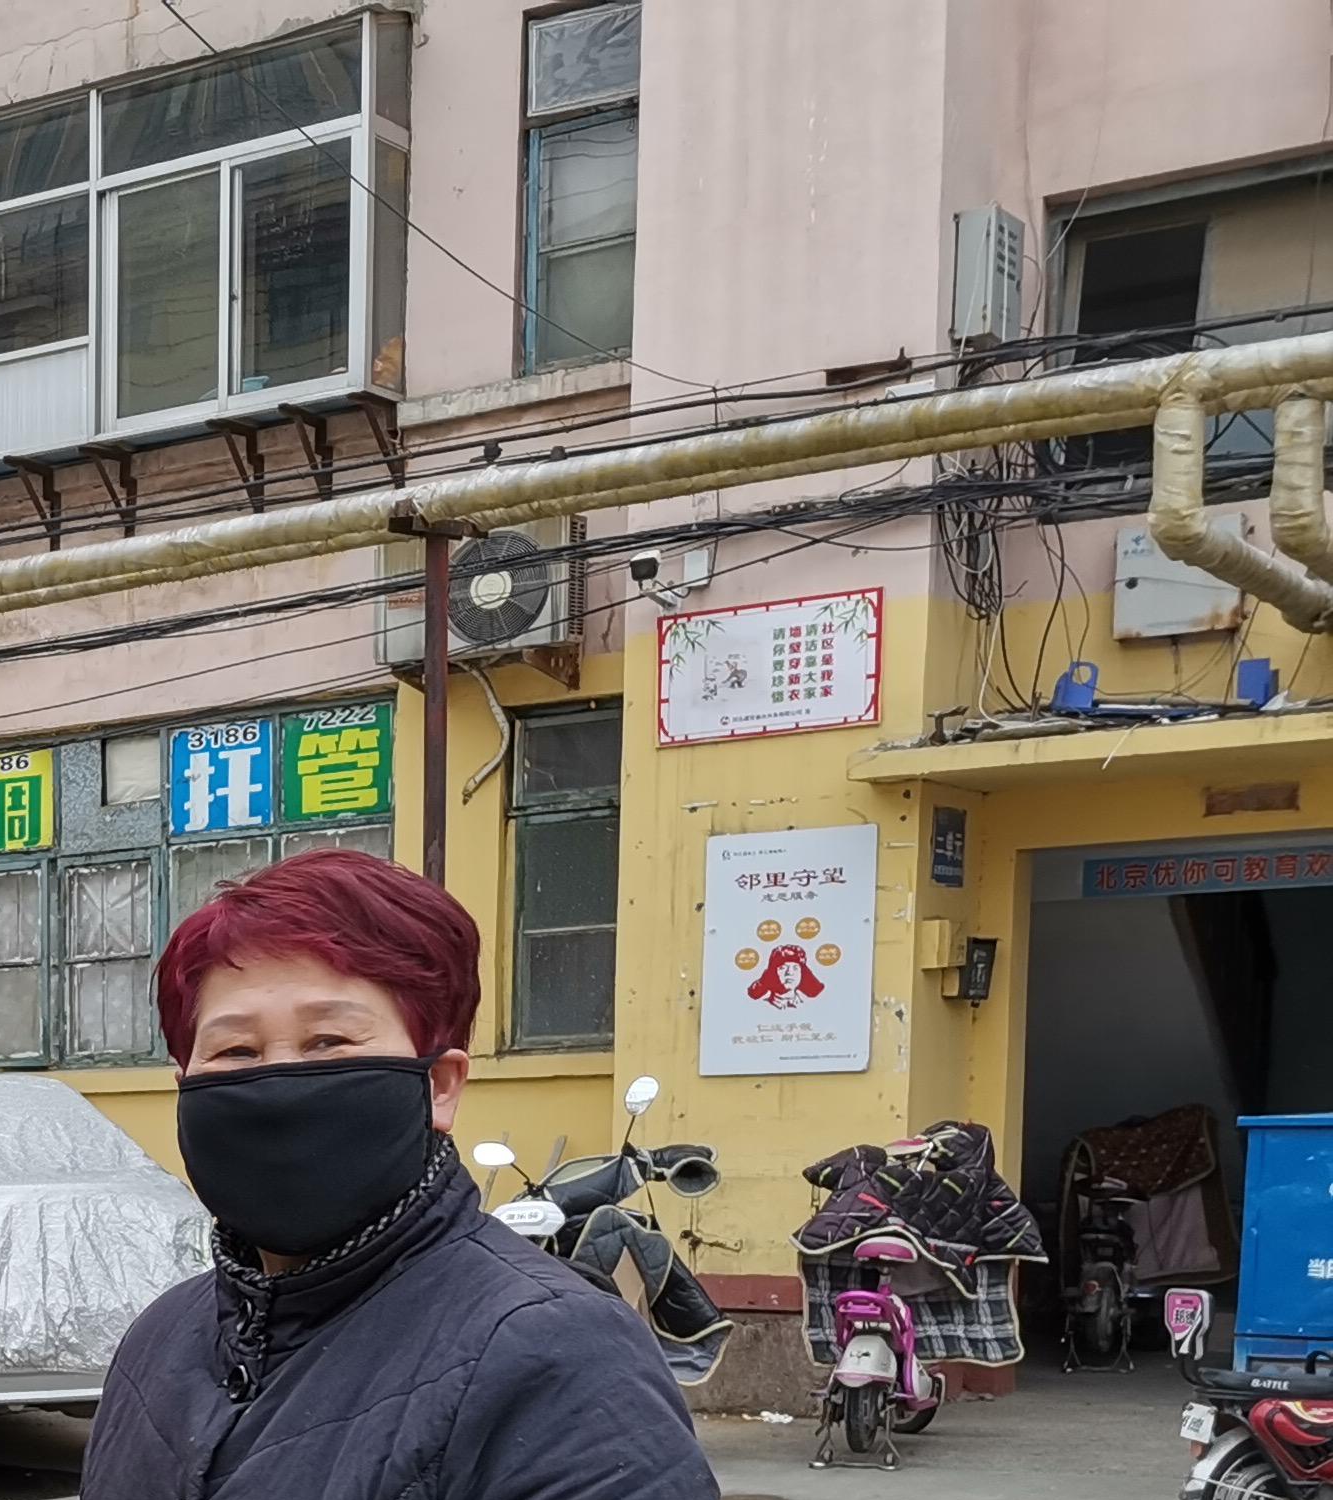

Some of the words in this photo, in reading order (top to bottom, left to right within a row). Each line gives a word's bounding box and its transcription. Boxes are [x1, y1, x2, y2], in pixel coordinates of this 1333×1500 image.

[188, 724, 260, 750] 3186
[734, 867, 847, 890] 邻里守望
[1250, 1378, 1290, 1391] BATTLE
